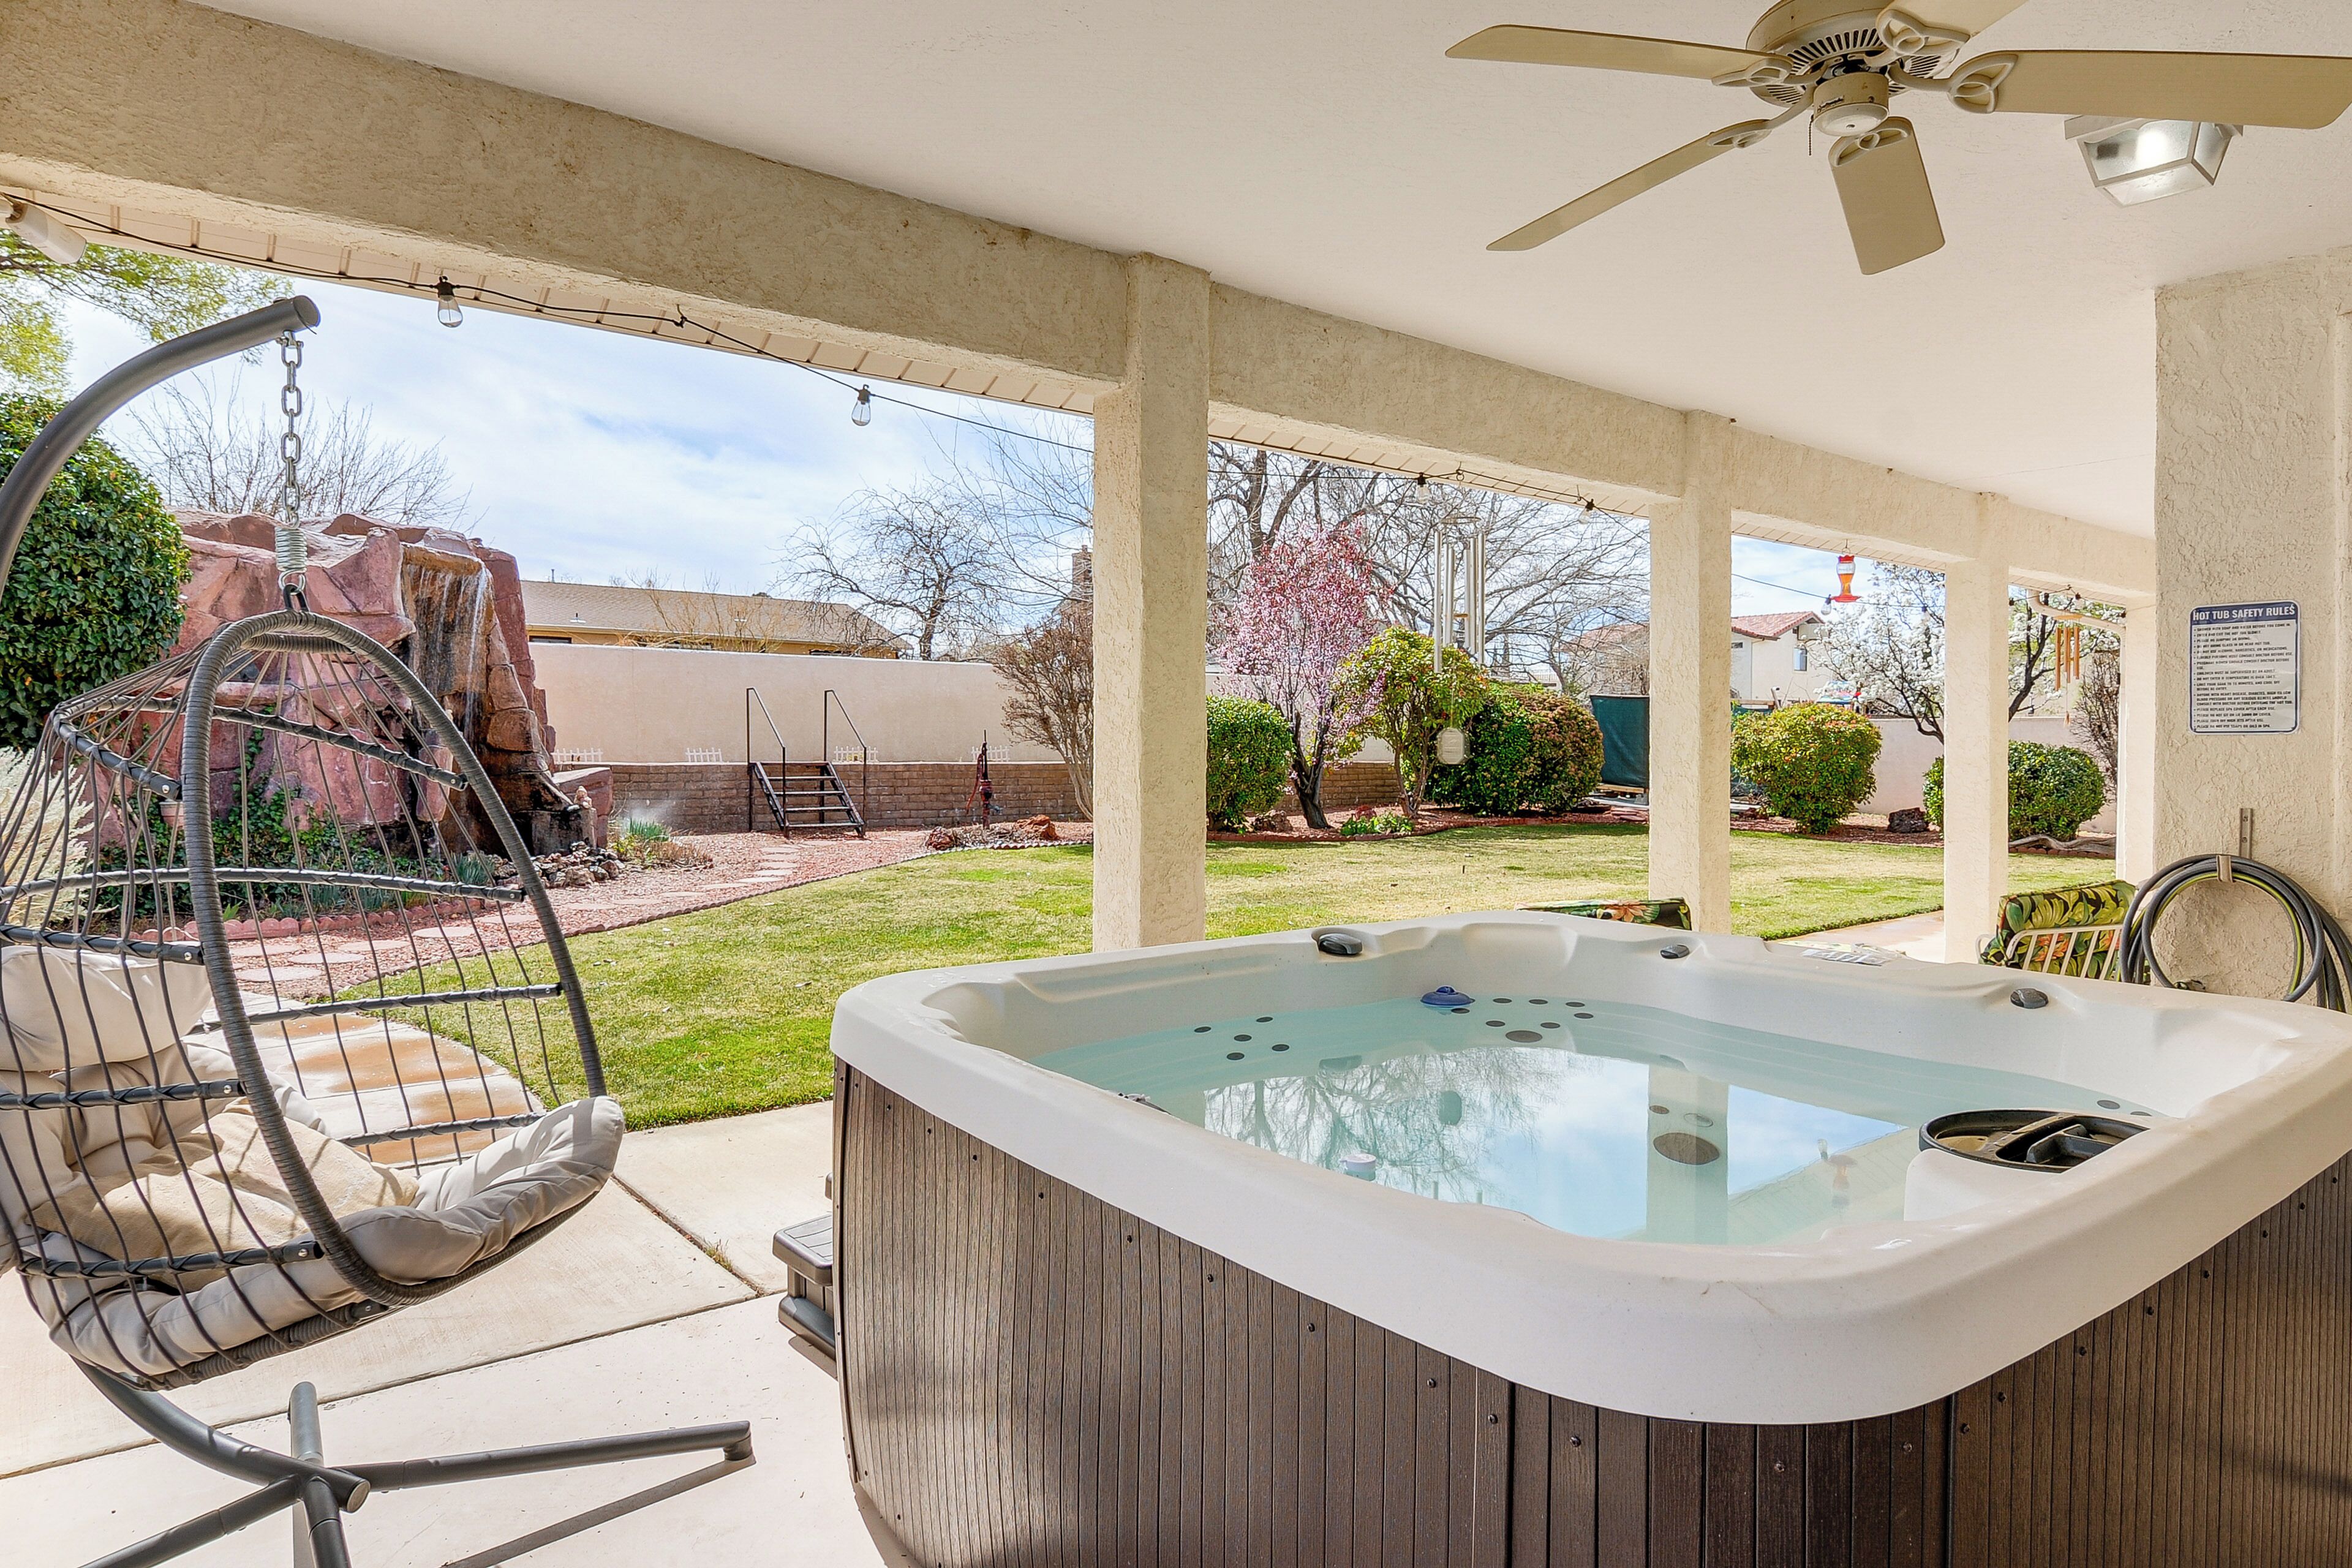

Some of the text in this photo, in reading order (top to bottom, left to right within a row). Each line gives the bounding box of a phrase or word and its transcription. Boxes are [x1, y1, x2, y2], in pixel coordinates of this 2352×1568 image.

[2193, 606, 2295, 621] HOT TUB SAFETY RULES
